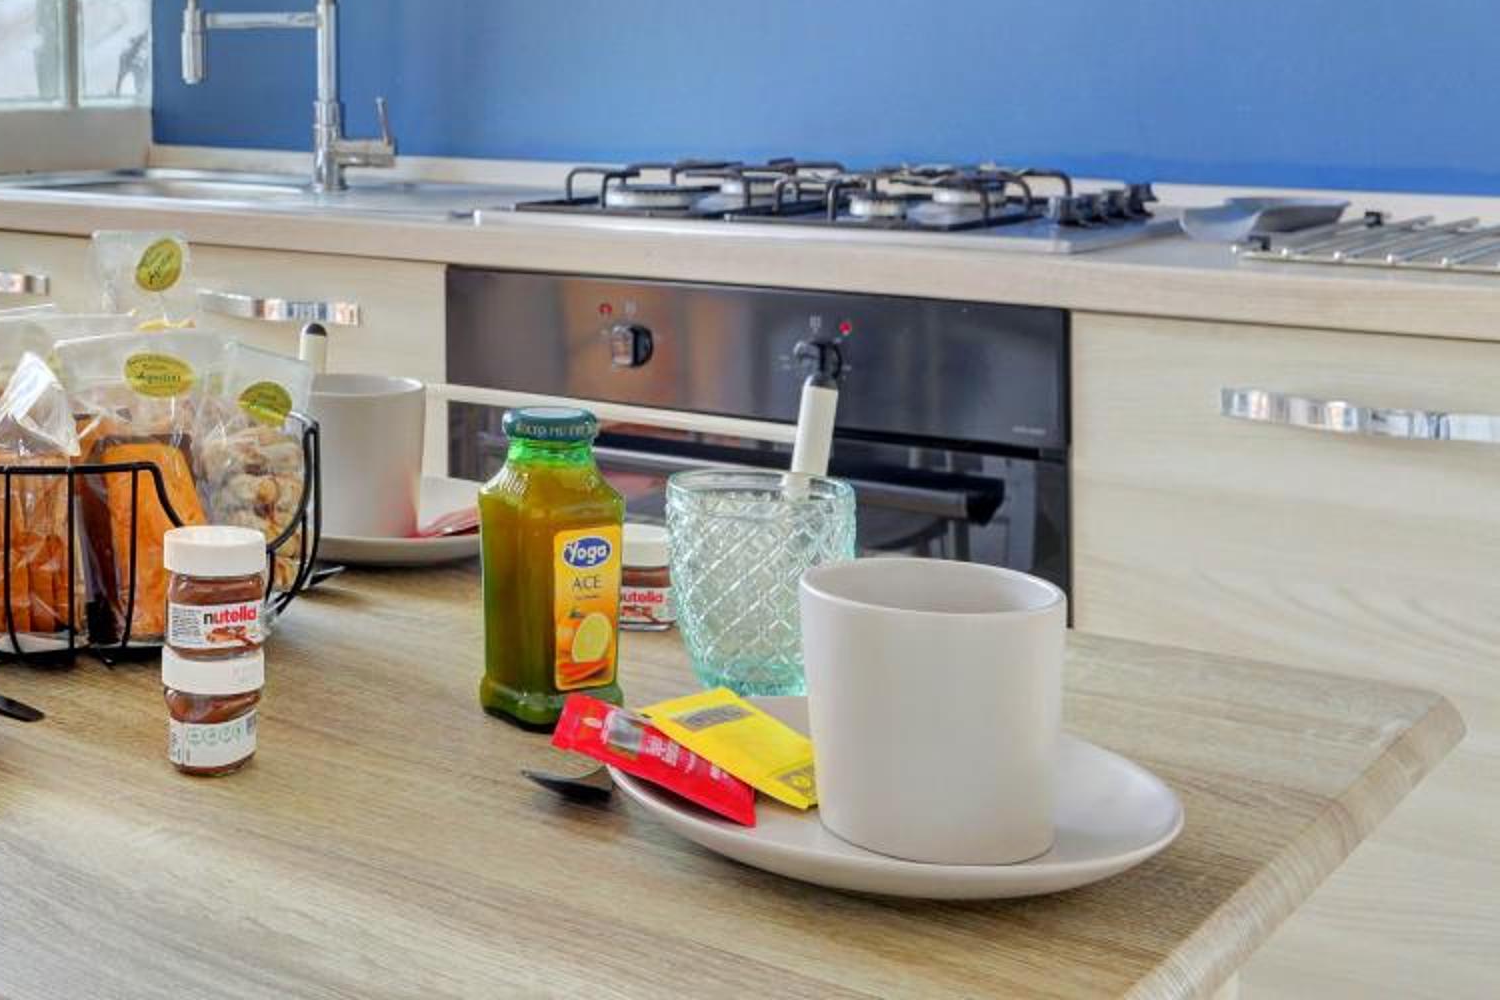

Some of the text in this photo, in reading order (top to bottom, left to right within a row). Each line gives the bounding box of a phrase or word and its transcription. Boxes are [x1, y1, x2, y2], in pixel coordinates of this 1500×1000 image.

[565, 541, 607, 565] Yoga
[572, 575, 602, 591] ACE
[203, 605, 257, 625] nutella
